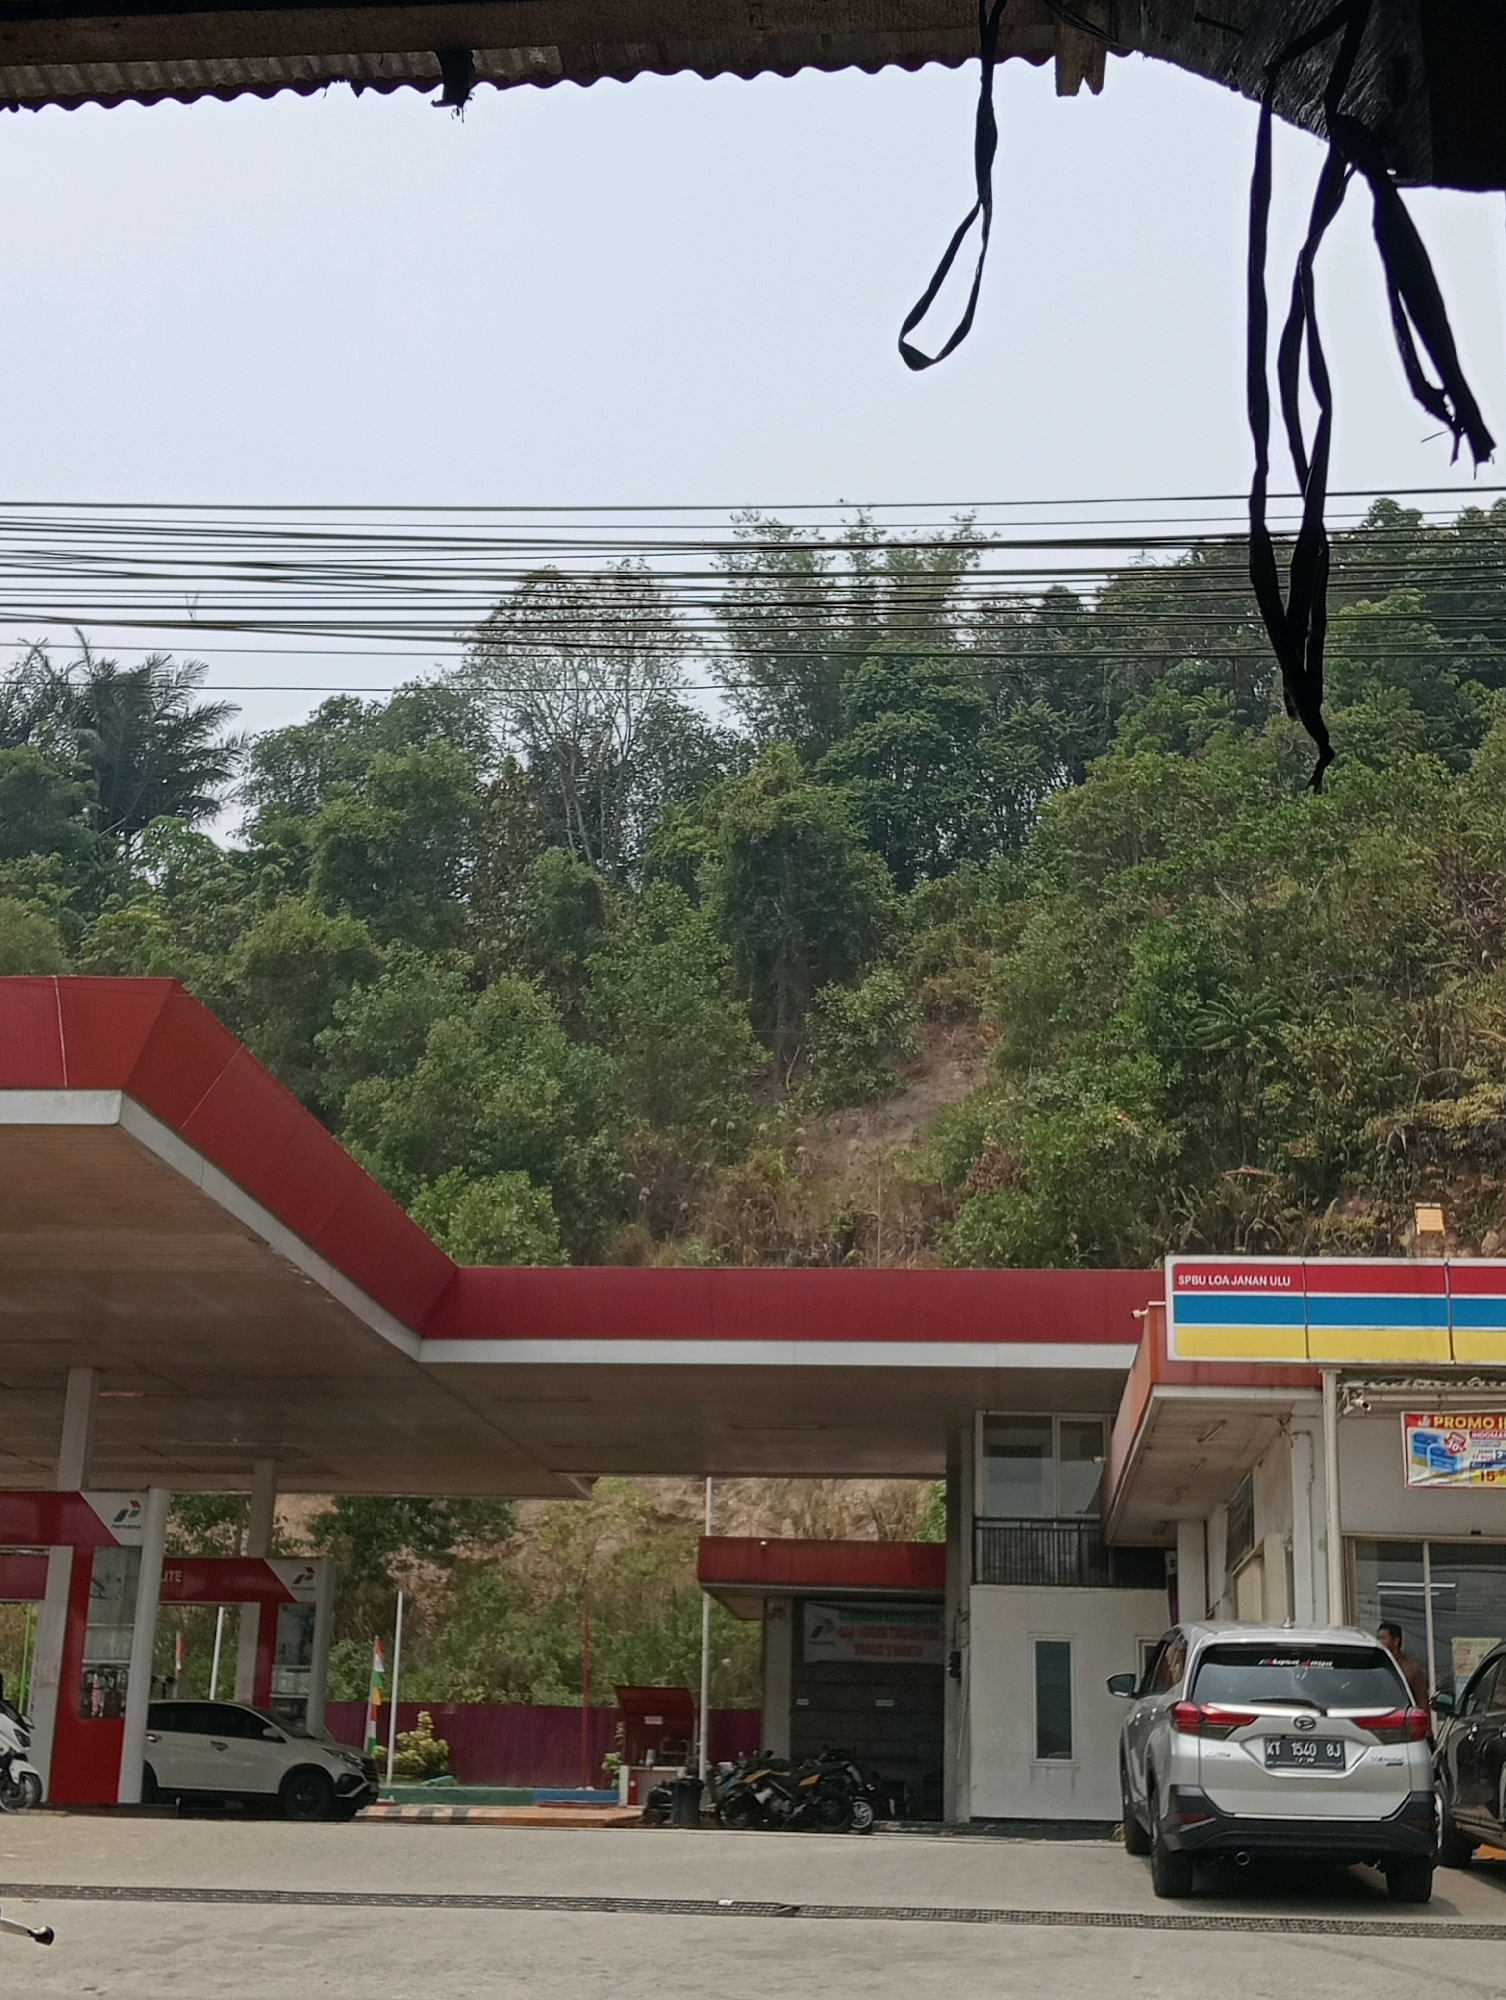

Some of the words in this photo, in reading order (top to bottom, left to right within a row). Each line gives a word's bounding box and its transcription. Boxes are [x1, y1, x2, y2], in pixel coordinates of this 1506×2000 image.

[1178, 1275, 1205, 1285] SPBU
[1208, 1275, 1229, 1285] LOA
[1230, 1275, 1267, 1286] JANAN
[1269, 1275, 1291, 1287] ULU
[1433, 1415, 1495, 1429] PROMO
[1266, 1741, 1281, 1755] KT
